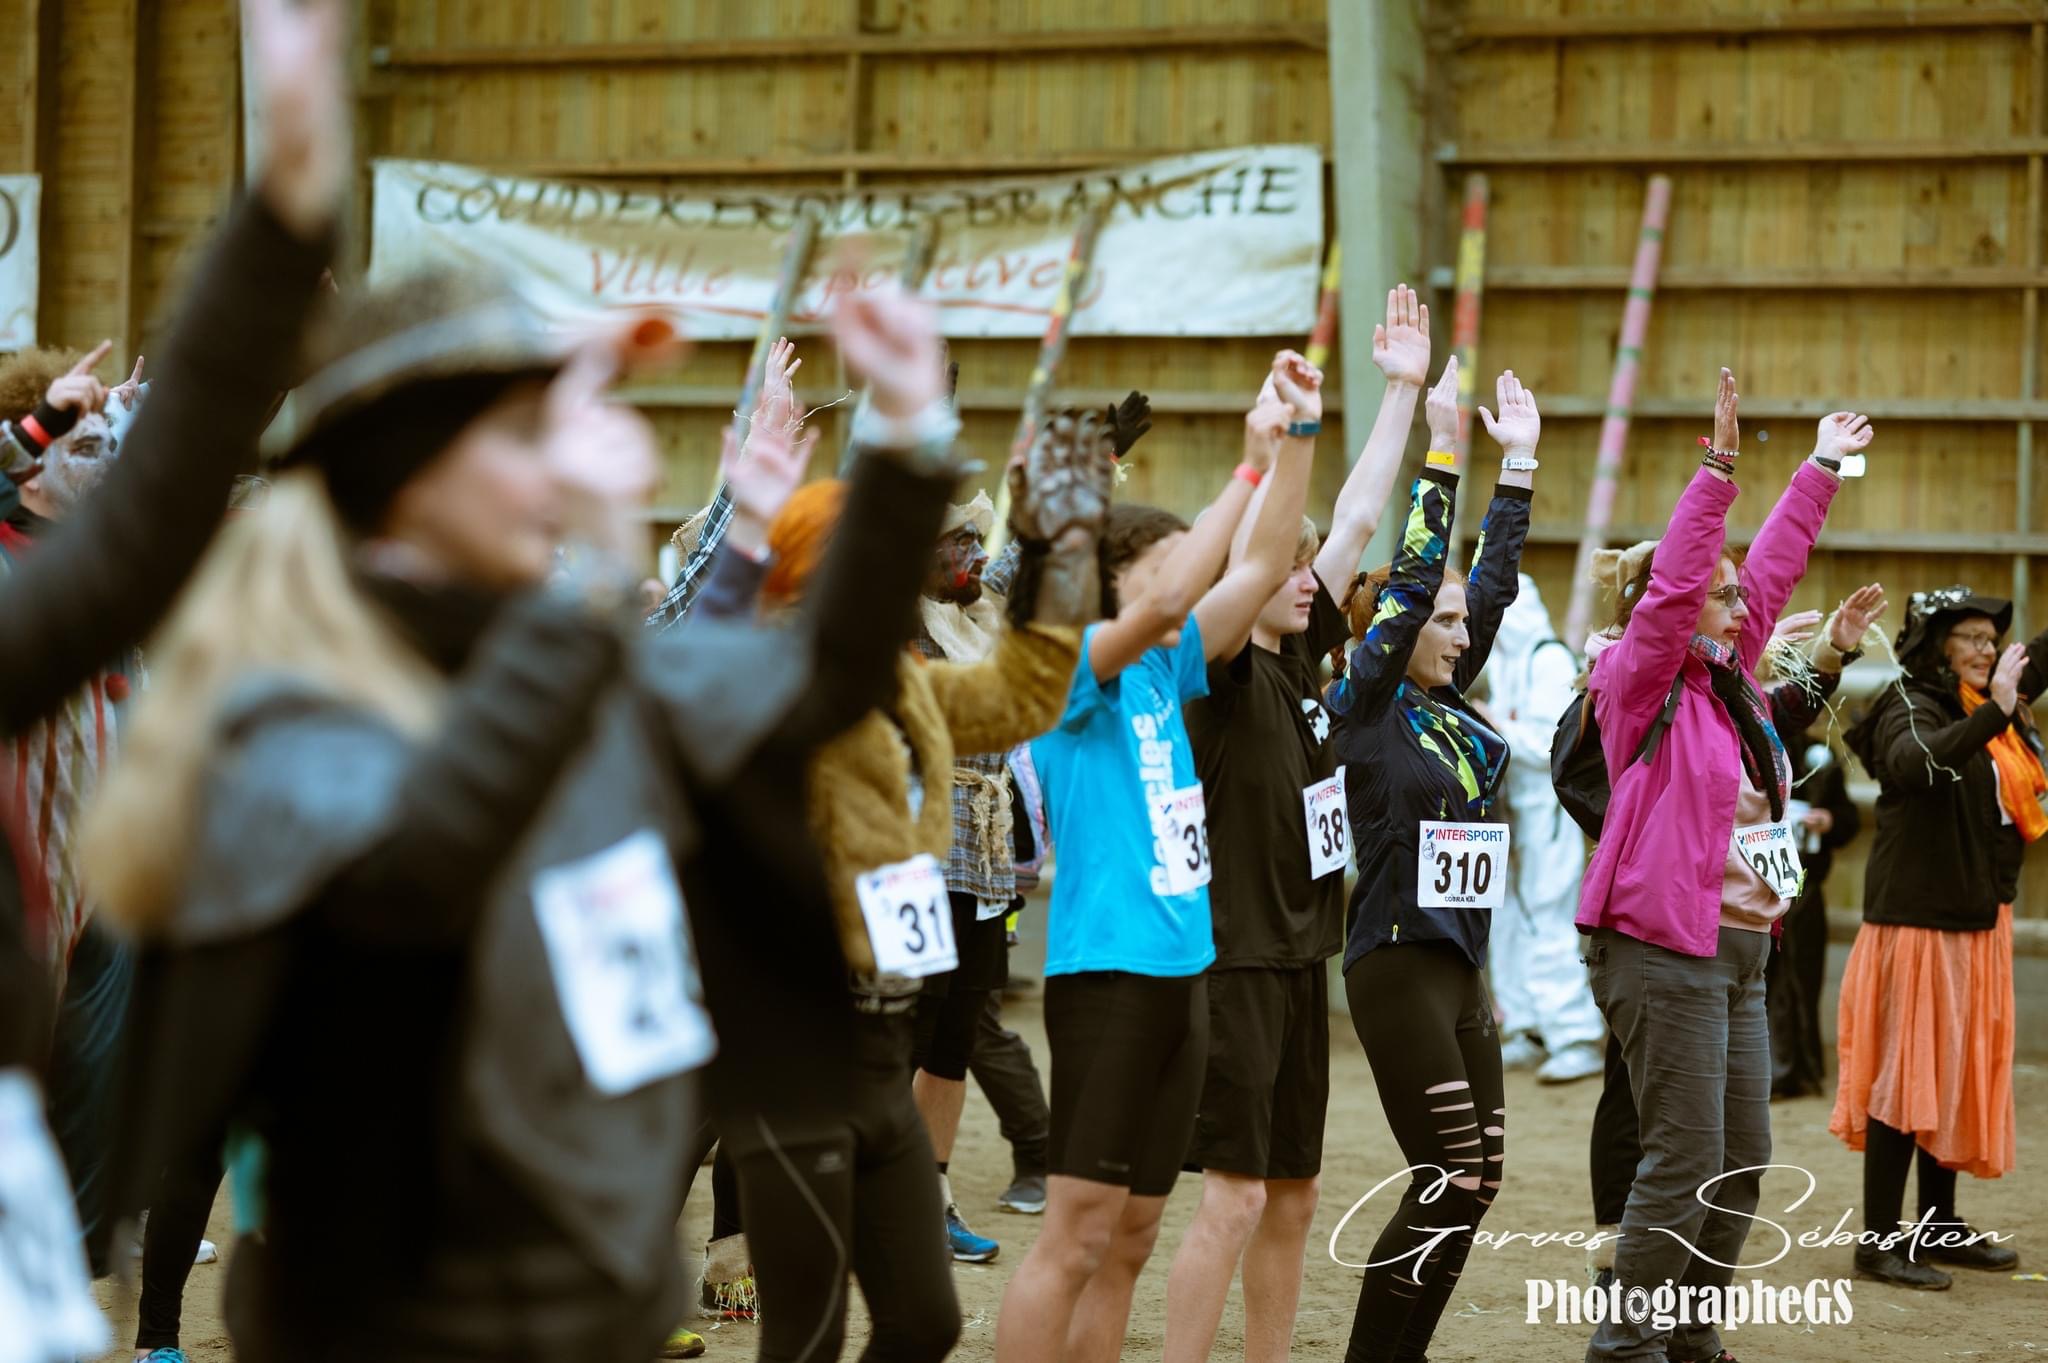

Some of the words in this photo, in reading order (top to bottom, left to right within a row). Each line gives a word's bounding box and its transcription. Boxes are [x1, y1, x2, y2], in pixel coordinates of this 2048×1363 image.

[589, 244, 733, 296] Ville
[1435, 828, 1504, 842] INTERSPORT
[1434, 851, 1492, 895] 310
[1753, 847, 1798, 889] 214
